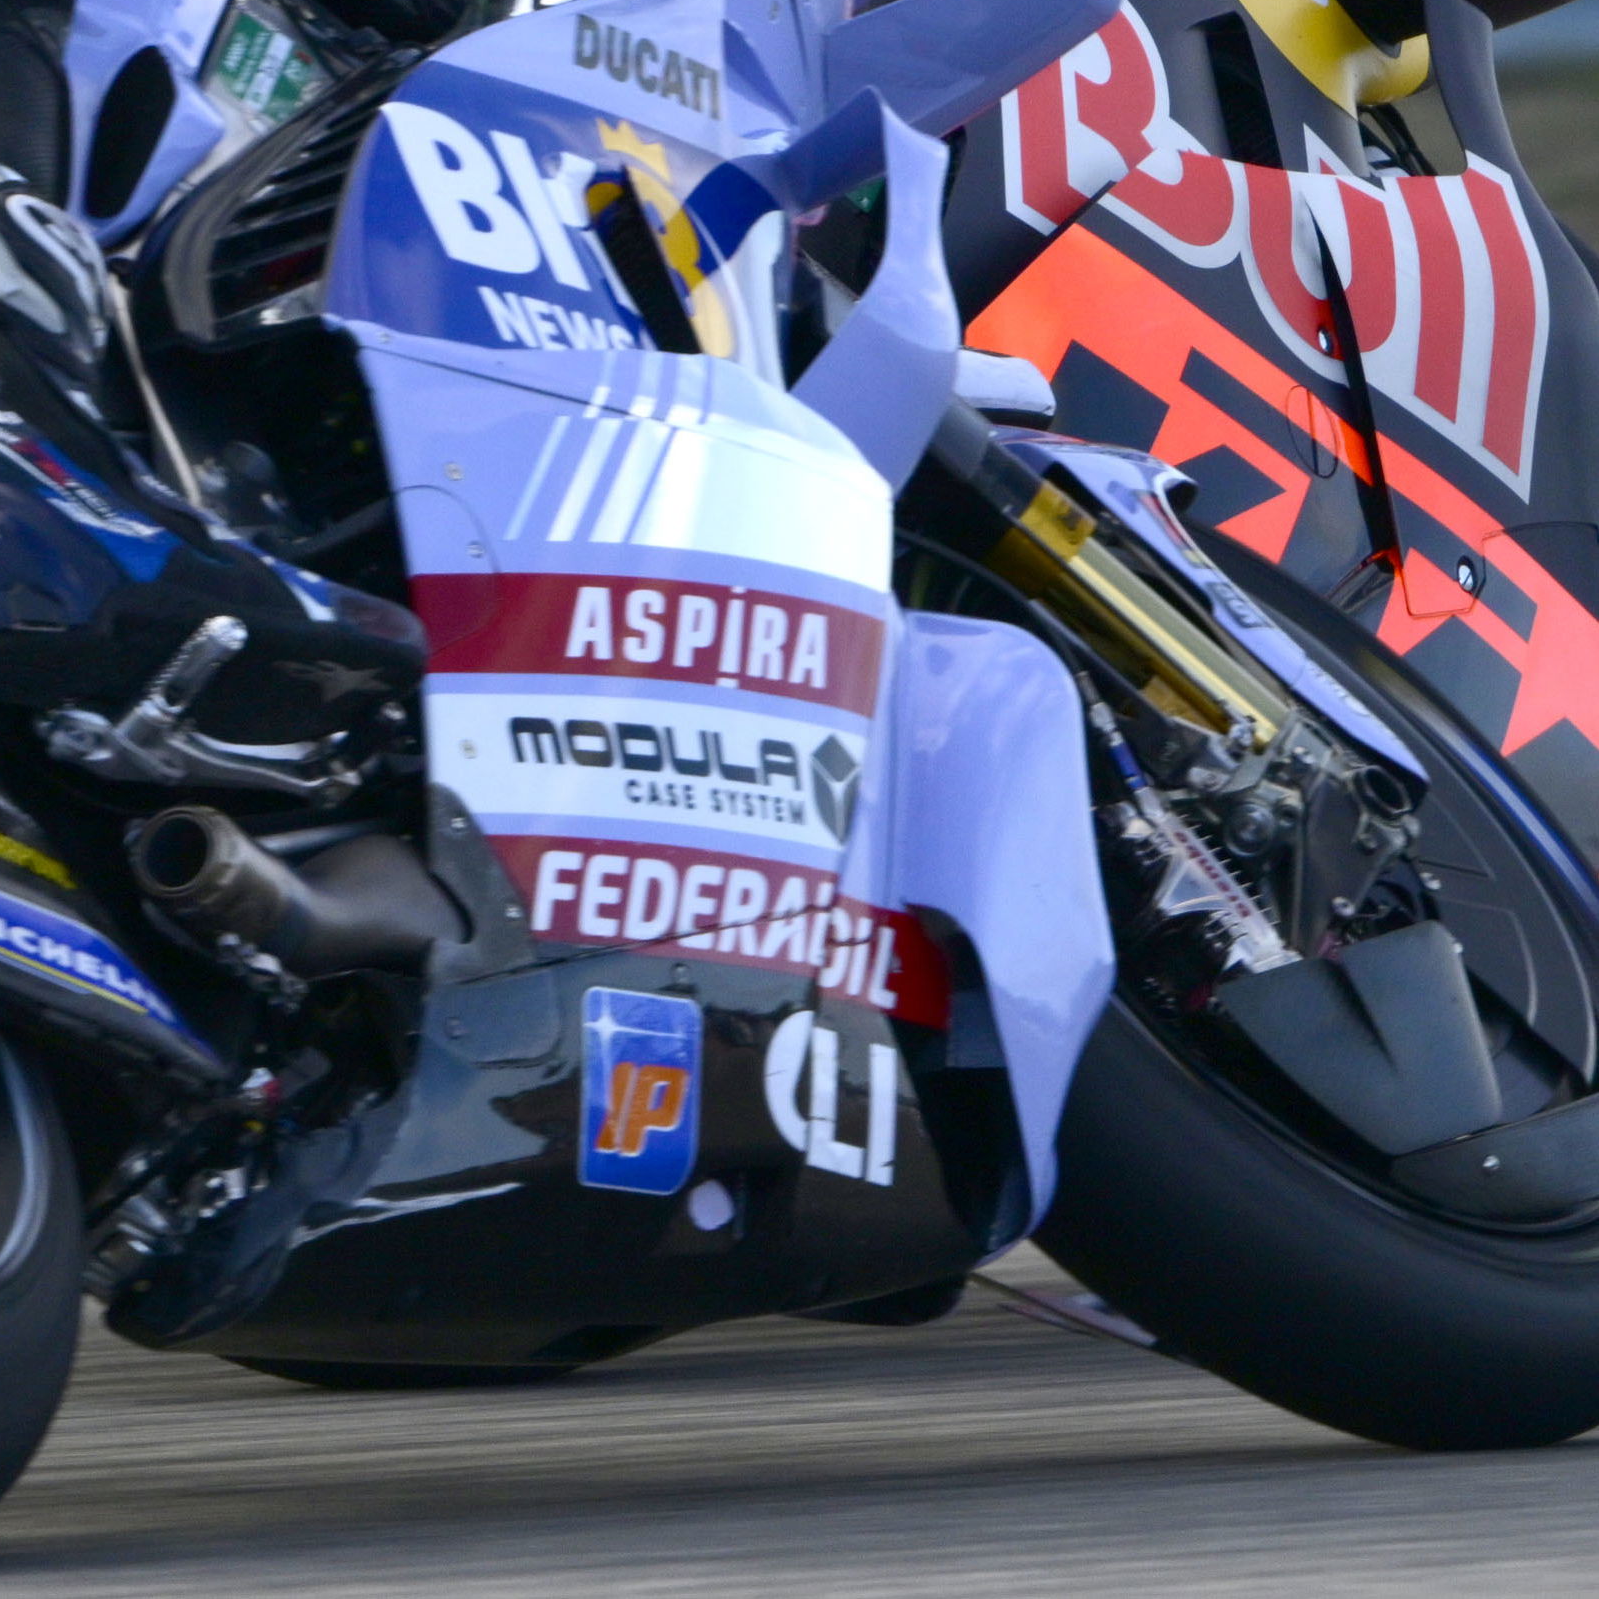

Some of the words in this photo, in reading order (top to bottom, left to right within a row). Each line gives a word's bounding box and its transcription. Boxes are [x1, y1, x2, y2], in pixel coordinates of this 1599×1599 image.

[574, 13, 723, 122] DUCATI
[565, 586, 829, 690] ASPIRA
[508, 716, 804, 791] MODULA
[624, 778, 697, 810] CASE
[710, 787, 806, 827] SYSTEM
